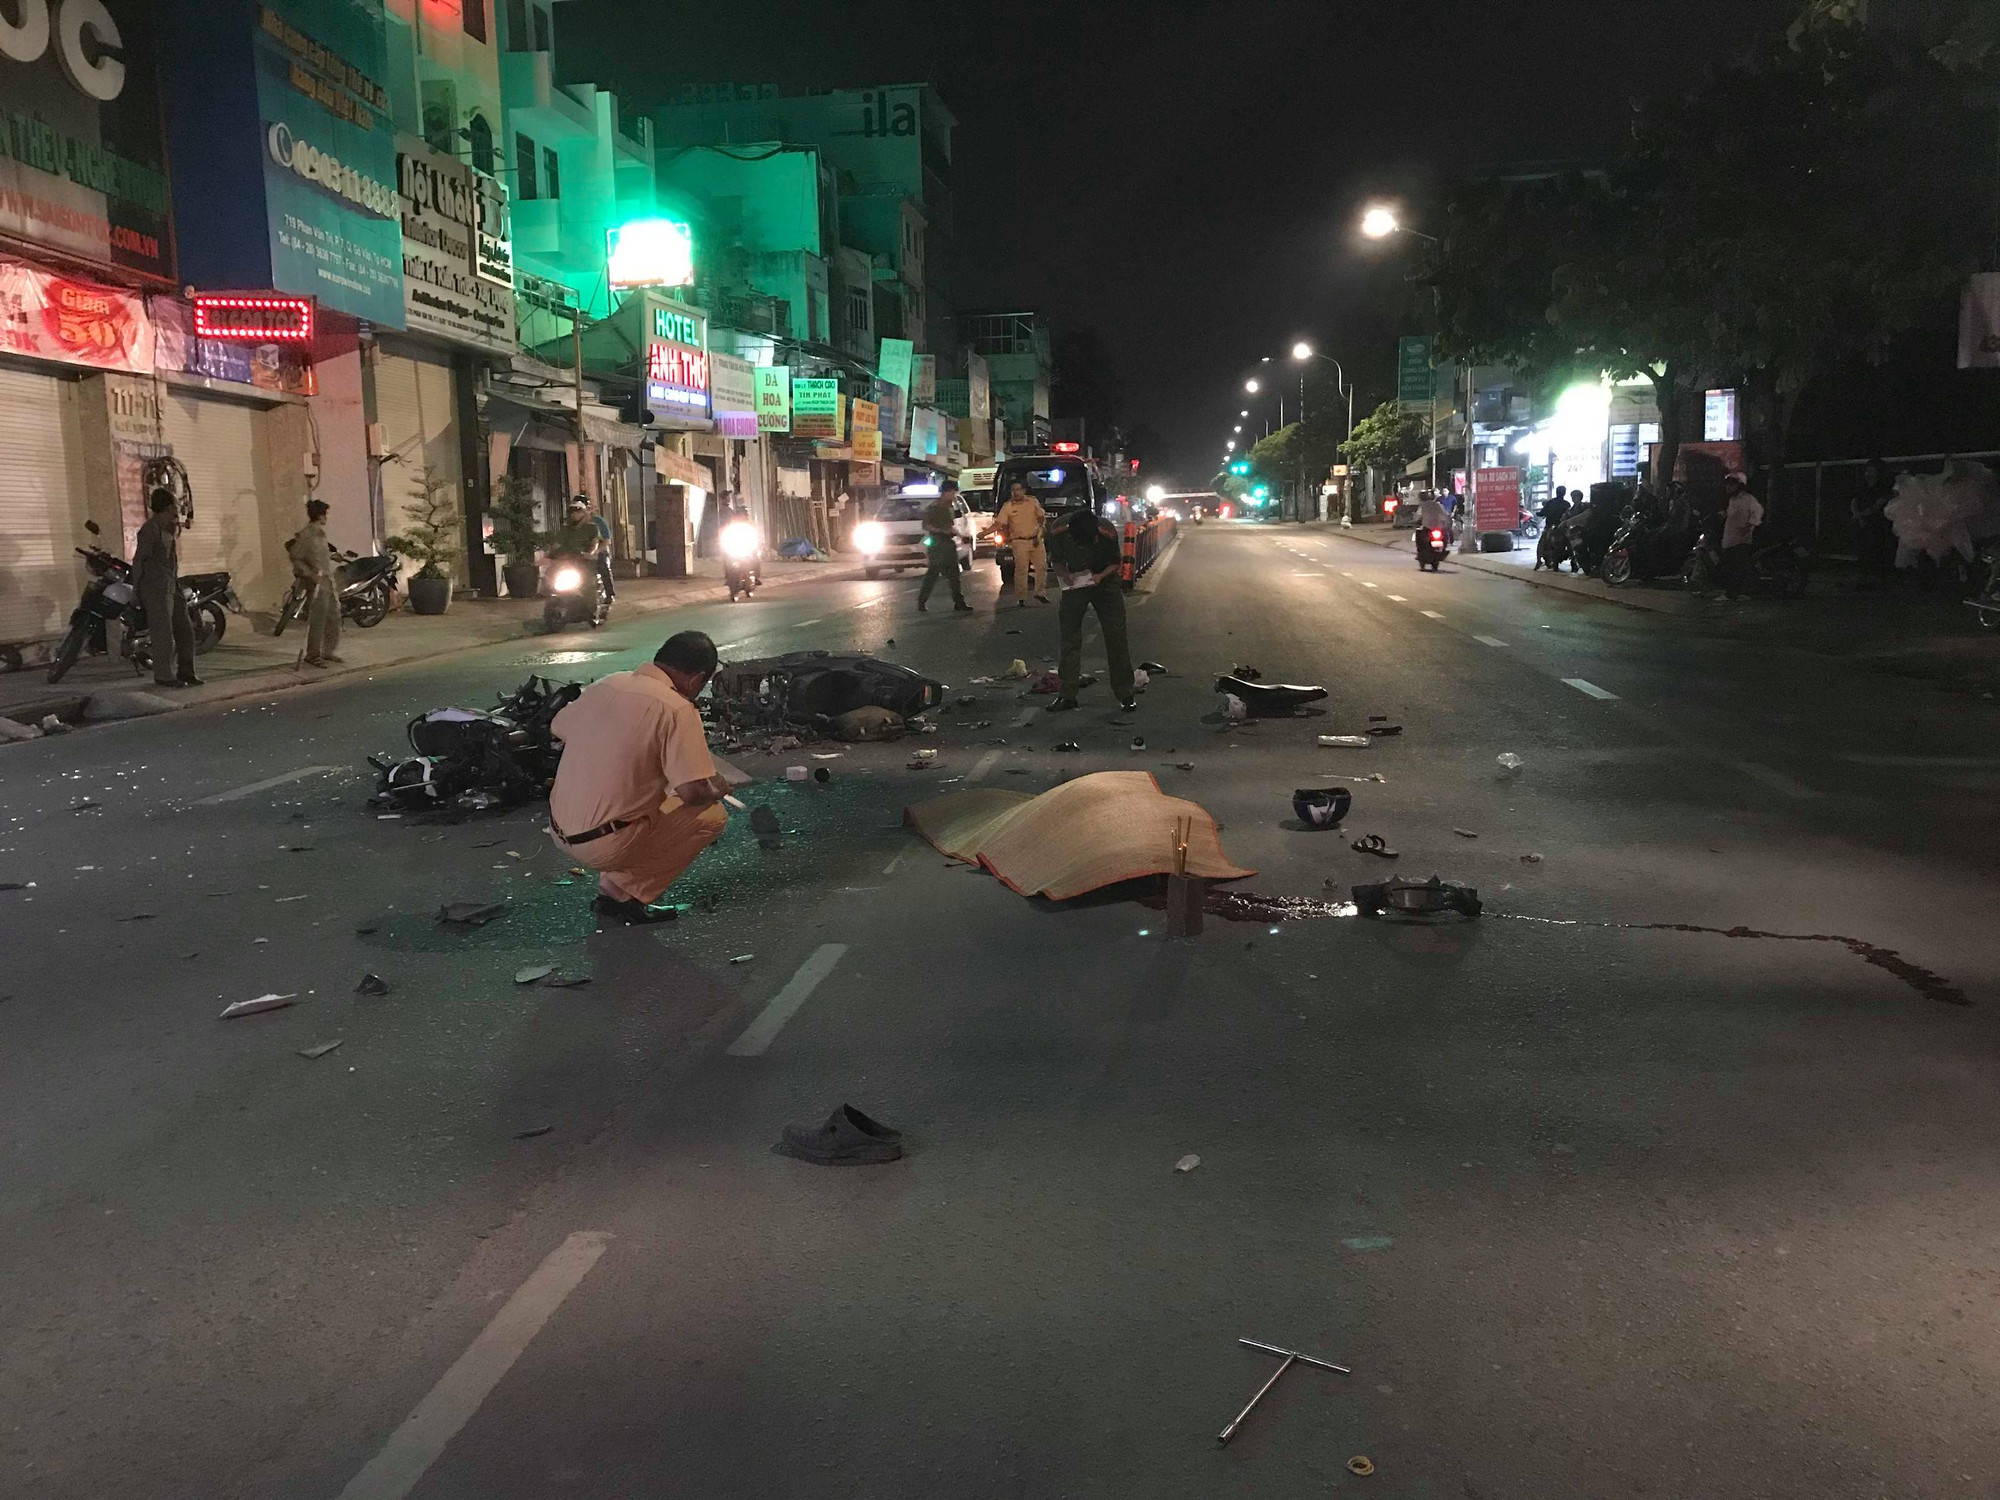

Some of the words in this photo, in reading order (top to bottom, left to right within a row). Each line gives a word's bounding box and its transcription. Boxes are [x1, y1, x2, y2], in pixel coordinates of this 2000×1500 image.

[863, 91, 916, 138] ila
[653, 308, 700, 347] HOTEL
[762, 392, 782, 407] HOA
